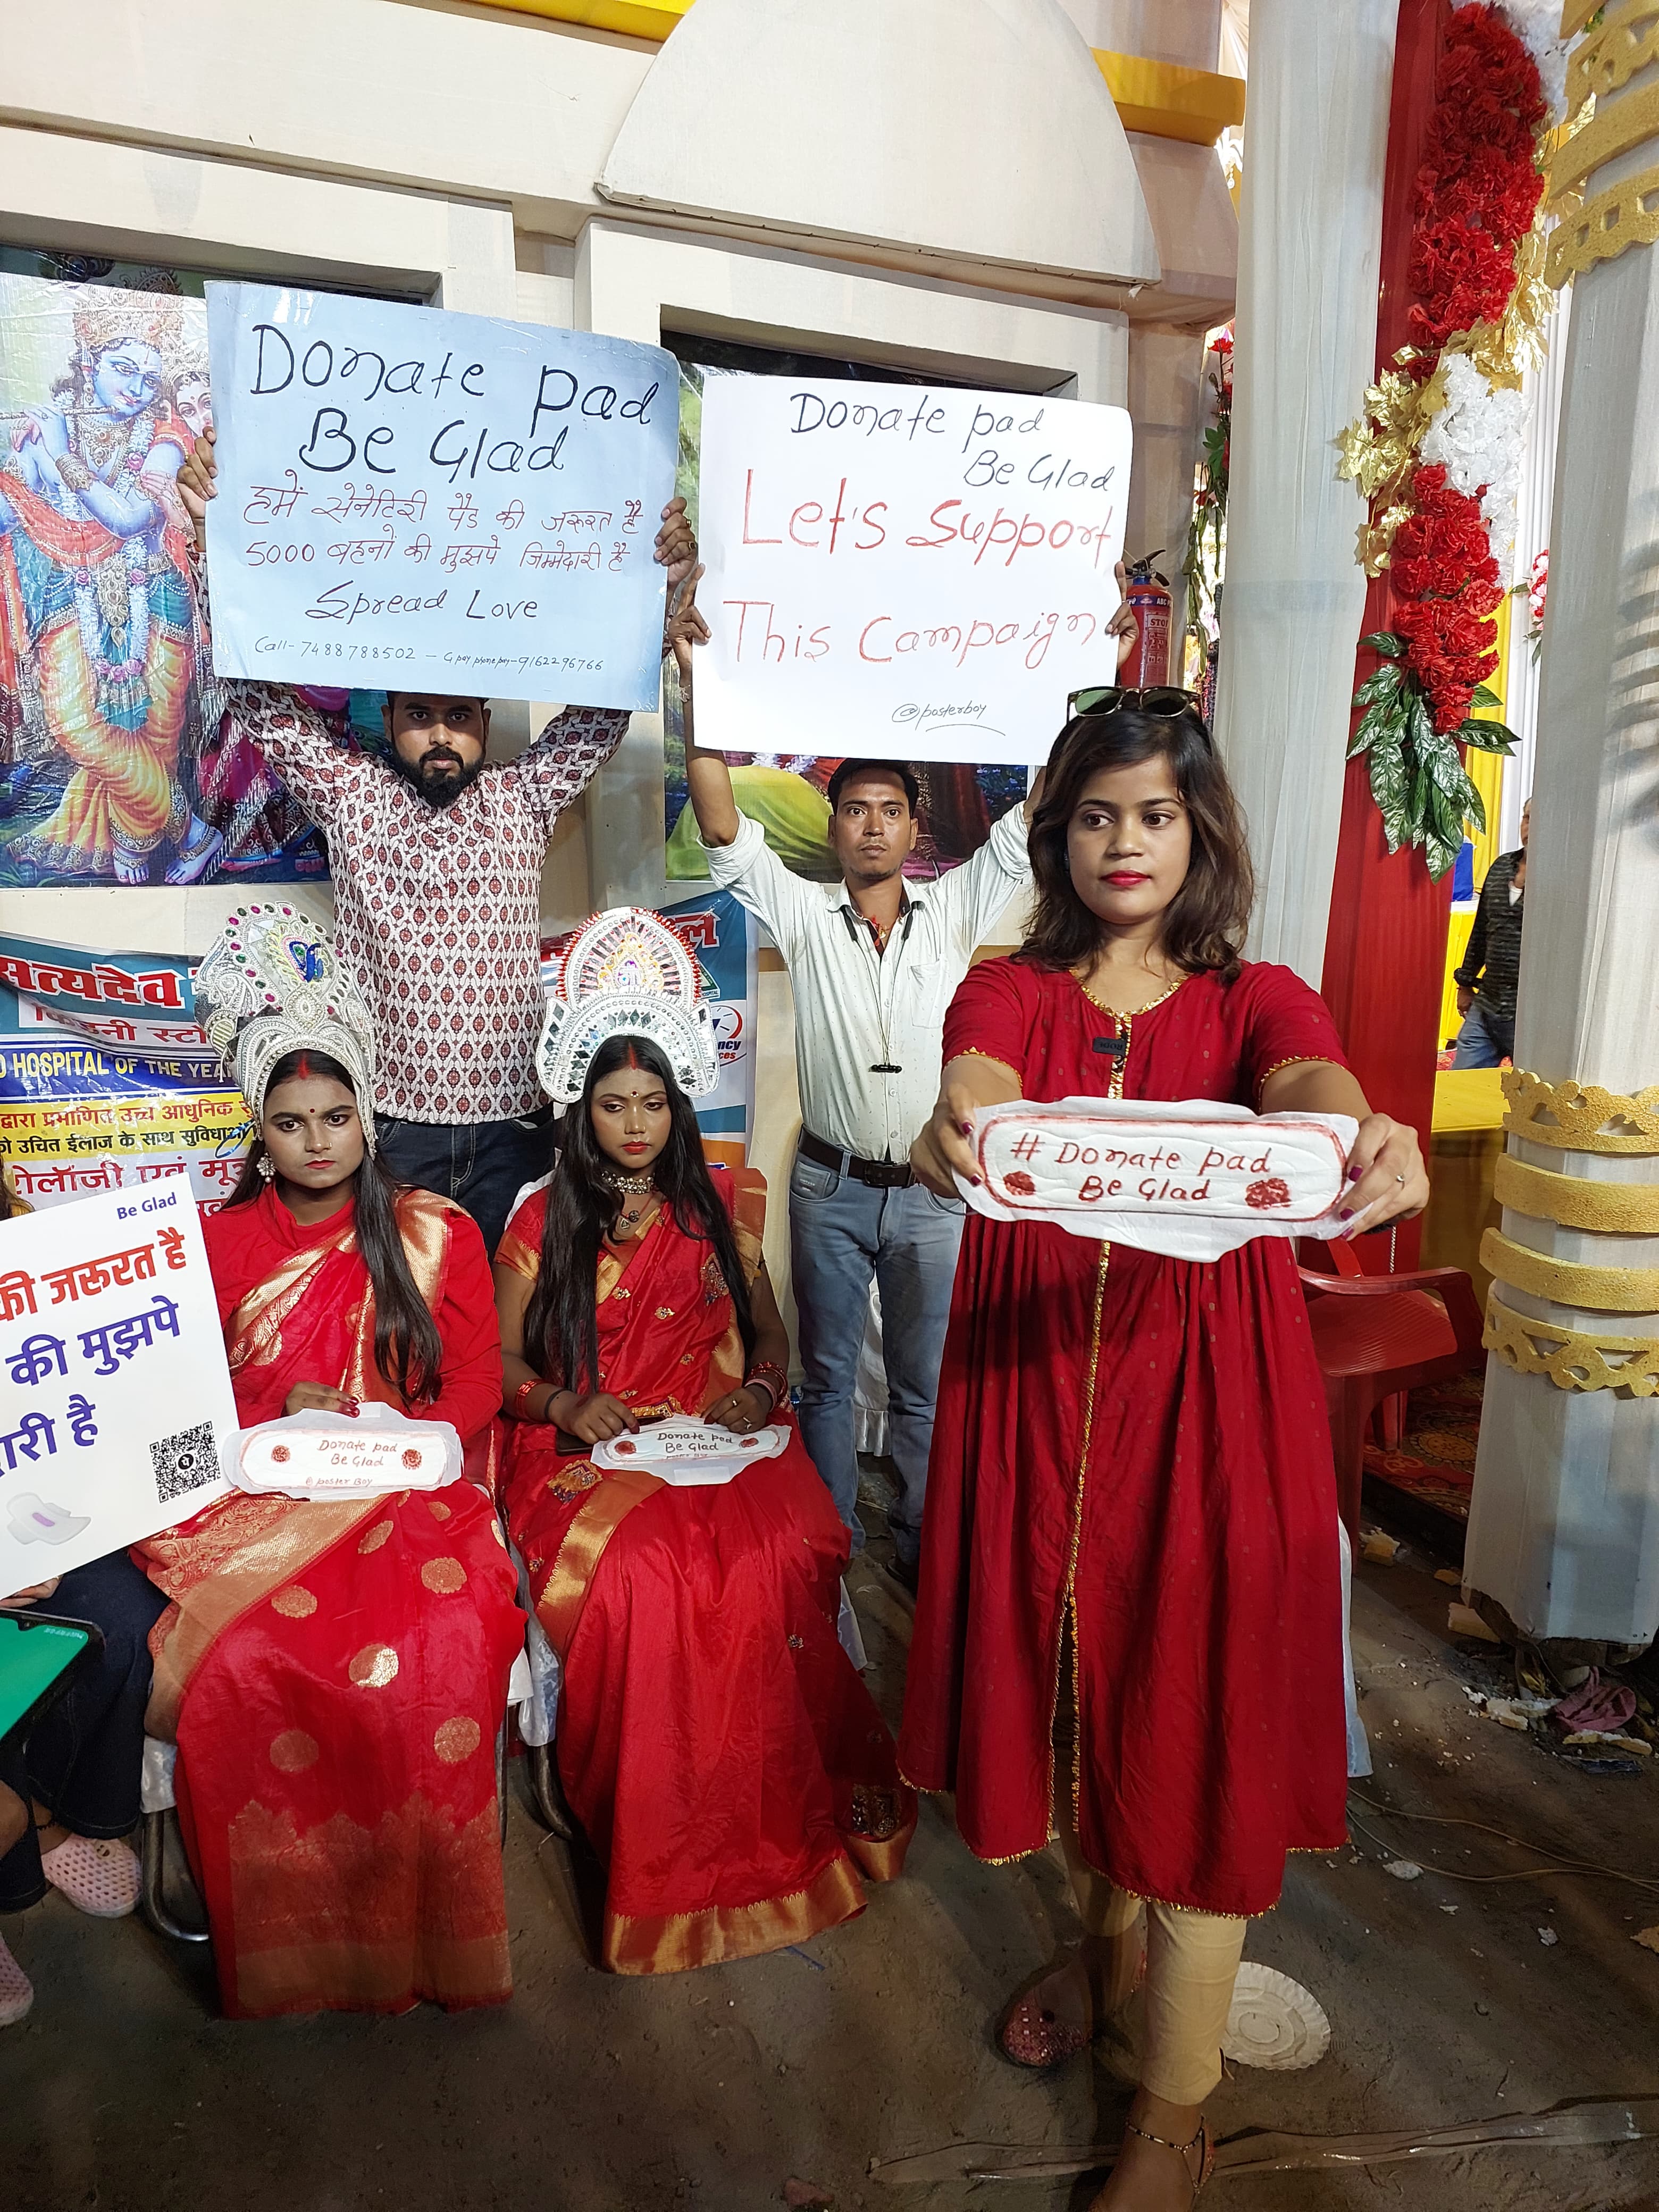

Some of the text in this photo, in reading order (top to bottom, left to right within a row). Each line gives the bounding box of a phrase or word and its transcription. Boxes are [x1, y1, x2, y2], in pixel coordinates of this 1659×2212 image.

[250, 324, 659, 438] Donate pad
[790, 393, 1045, 453] Donate pad
[299, 407, 569, 483] Be Glad
[963, 450, 1115, 492] Be Glad
[244, 469, 308, 524] हमें
[447, 492, 479, 531] पैड
[496, 499, 525, 530] की
[622, 499, 644, 534] है
[742, 468, 1113, 568] Let's Support
[246, 541, 315, 566] 5000
[327, 524, 398, 565] बहनों
[404, 533, 432, 563] की
[520, 540, 601, 572] जिम्मेदारी
[608, 541, 631, 571] है
[305, 581, 539, 624] Spread Love
[723, 600, 831, 663] This
[859, 610, 1096, 670] Campaign
[13, 1051, 110, 1078] HOSPITAL
[114, 1057, 141, 1075] OF
[144, 1059, 182, 1077] THE
[162, 1099, 234, 1123] आधुनिक
[16, 1136, 60, 1153] उचित
[66, 1133, 113, 1153] ईलाज
[120, 1130, 135, 1147] के
[140, 1130, 174, 1147] साथ
[1054, 1141, 1181, 1170] Donate
[1198, 1147, 1271, 1176] pad
[117, 1206, 137, 1220] Be
[141, 1192, 177, 1213] Glad
[1078, 1176, 1212, 1202] Be Glad
[41, 1243, 158, 1305] जरूरत
[156, 1227, 187, 1270] है
[5, 1295, 181, 1386] की मुझपे
[66, 1394, 99, 1447] है
[657, 1432, 734, 1443] Donate pad
[317, 1439, 398, 1452] Donate pad
[331, 1453, 383, 1468] Be Glad
[665, 1442, 719, 1453] Be Glad
